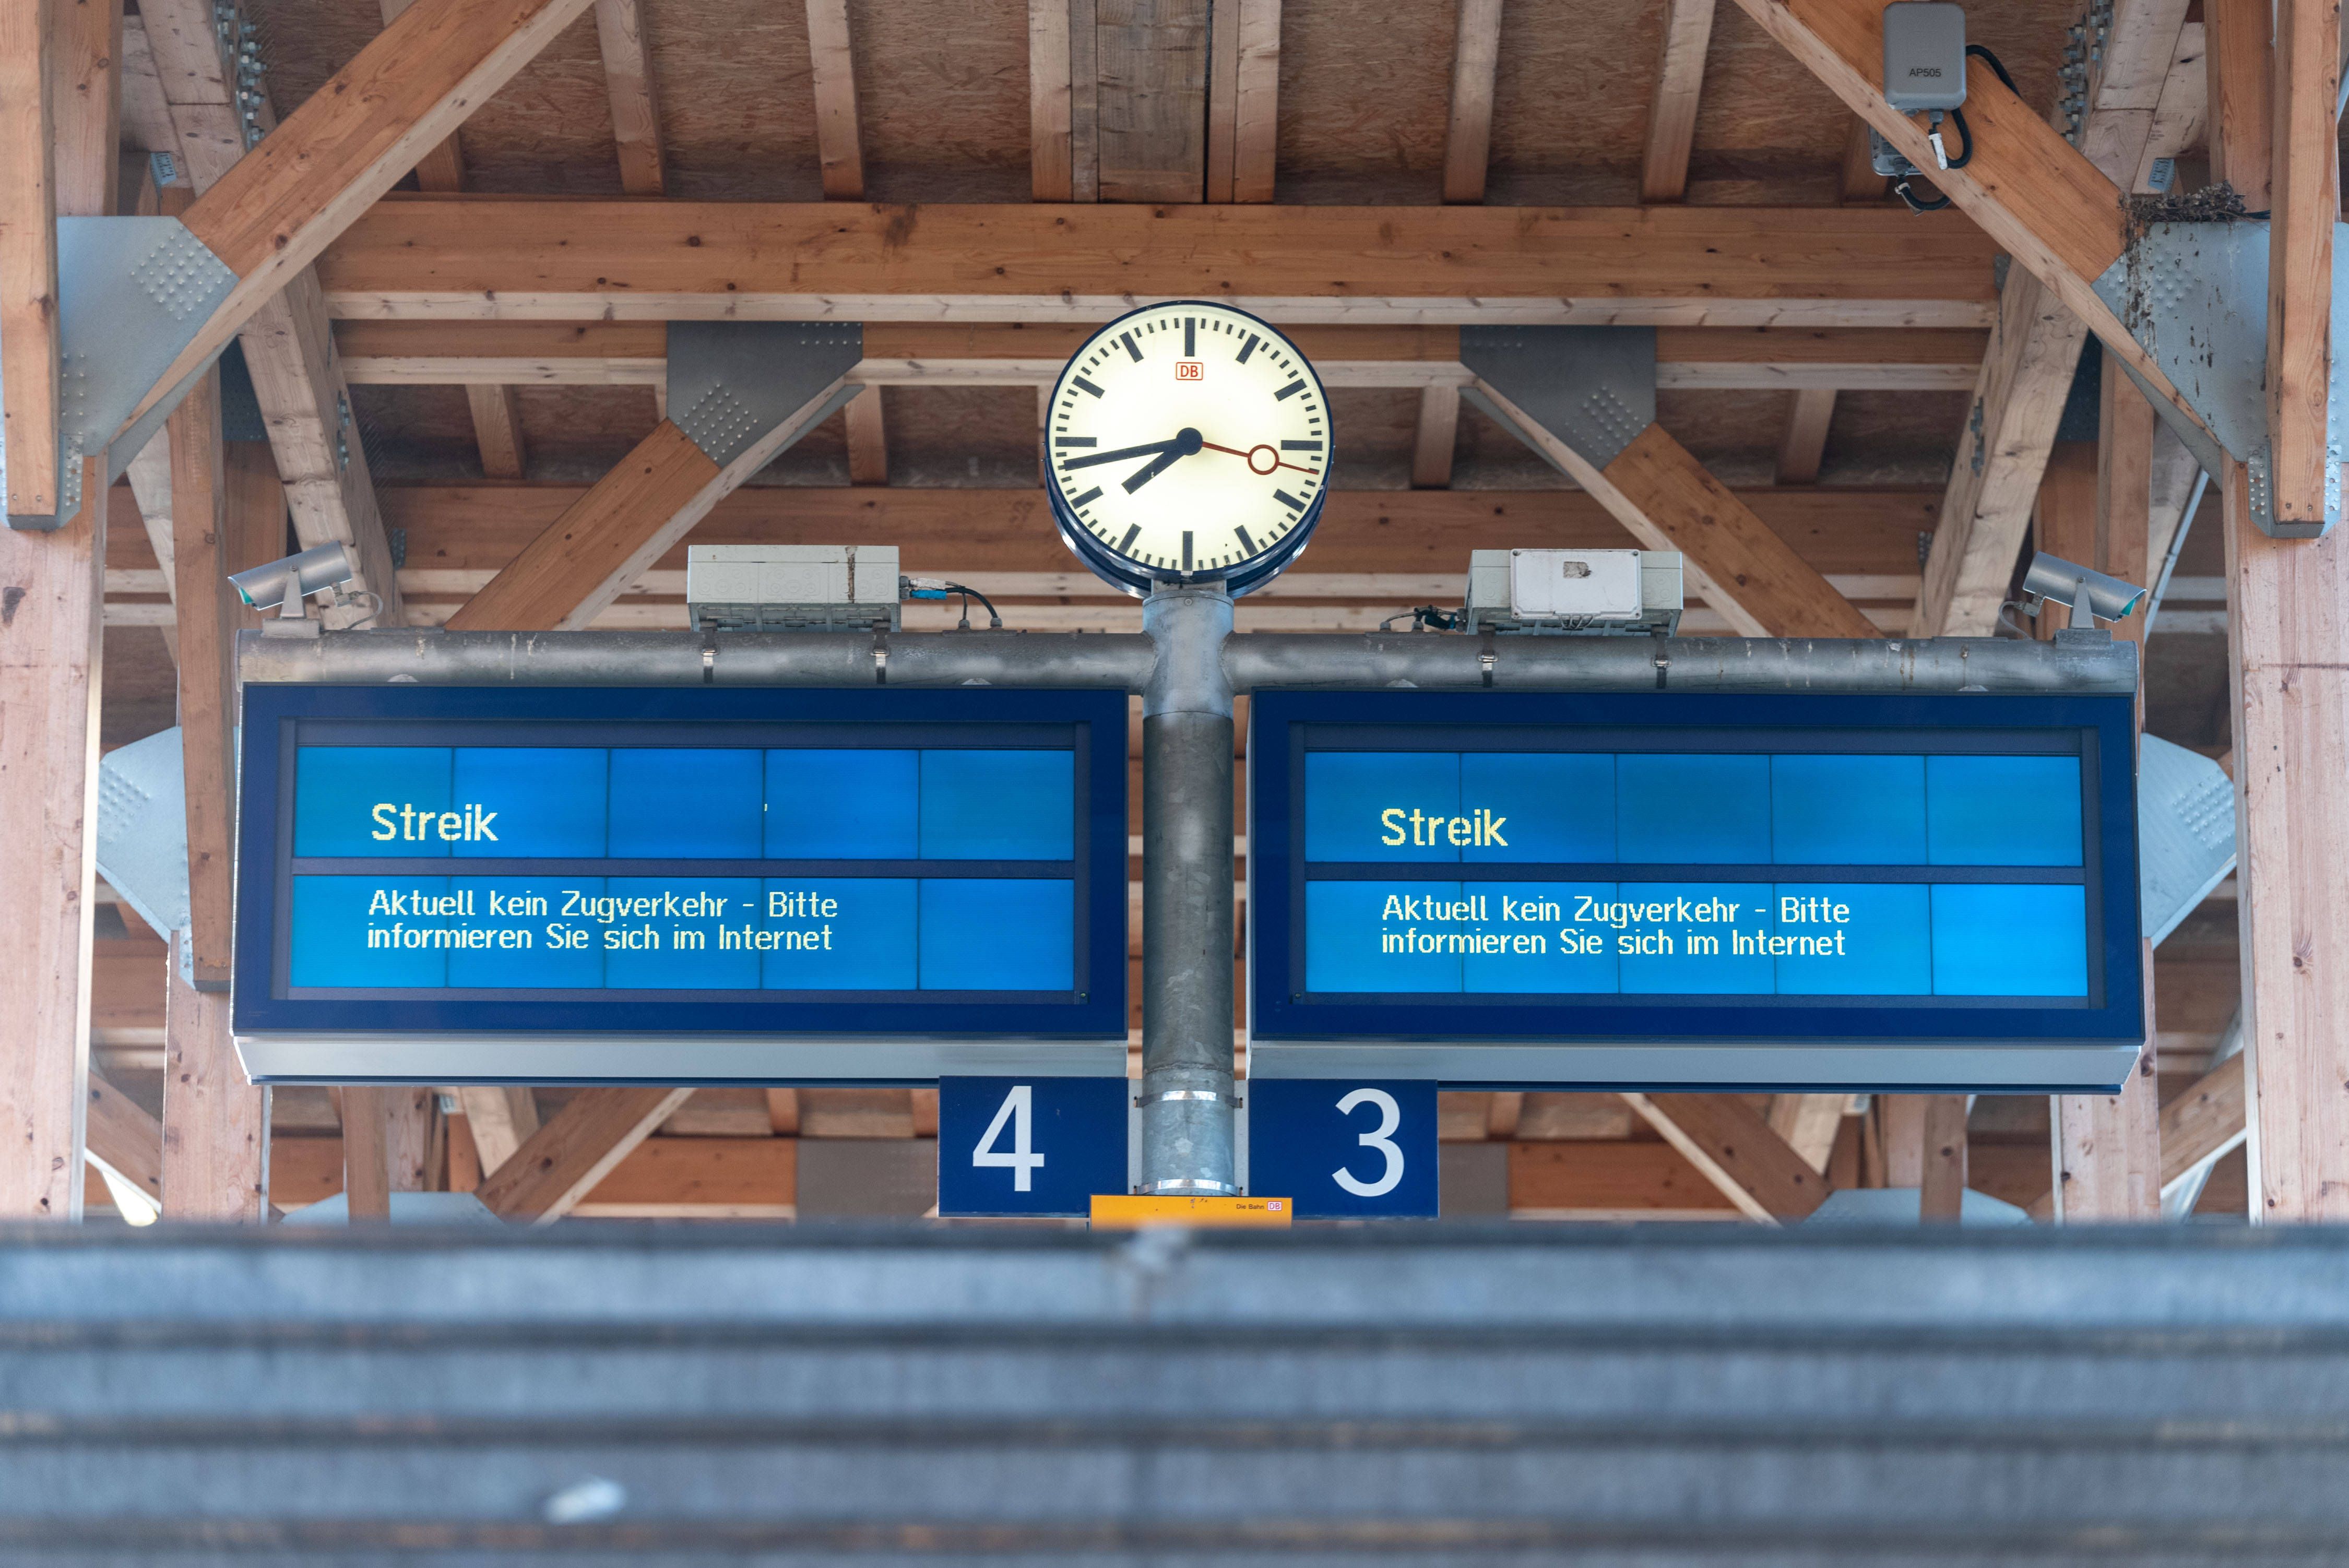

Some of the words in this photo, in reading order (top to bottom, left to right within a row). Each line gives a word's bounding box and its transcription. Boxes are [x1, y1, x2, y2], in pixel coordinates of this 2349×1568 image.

[1909, 68, 1942, 77] AP505
[1180, 364, 1200, 378] DB
[372, 804, 499, 841] Streik
[1382, 809, 1509, 847] Streik
[369, 890, 476, 916] Aktuell
[490, 890, 548, 917] kein
[562, 890, 728, 923] Zugverkehr
[769, 892, 838, 918] Bitte
[1383, 895, 1489, 921] Aktuell
[1503, 896, 1561, 922] kein
[1575, 896, 1740, 928] Zugverkehr
[1782, 897, 1850, 923] Bitte
[368, 923, 532, 949] informieren
[547, 923, 589, 949] Sie
[604, 924, 660, 949] sich
[674, 924, 705, 950] im
[720, 924, 833, 951] Internet
[1383, 929, 1547, 954] informieren
[1561, 929, 1603, 955] Sie
[1618, 929, 1674, 955] sich
[1688, 929, 1719, 955] im
[1733, 930, 1846, 956] Internet
[972, 1086, 1045, 1192] 4
[1332, 1088, 1405, 1197] 3
